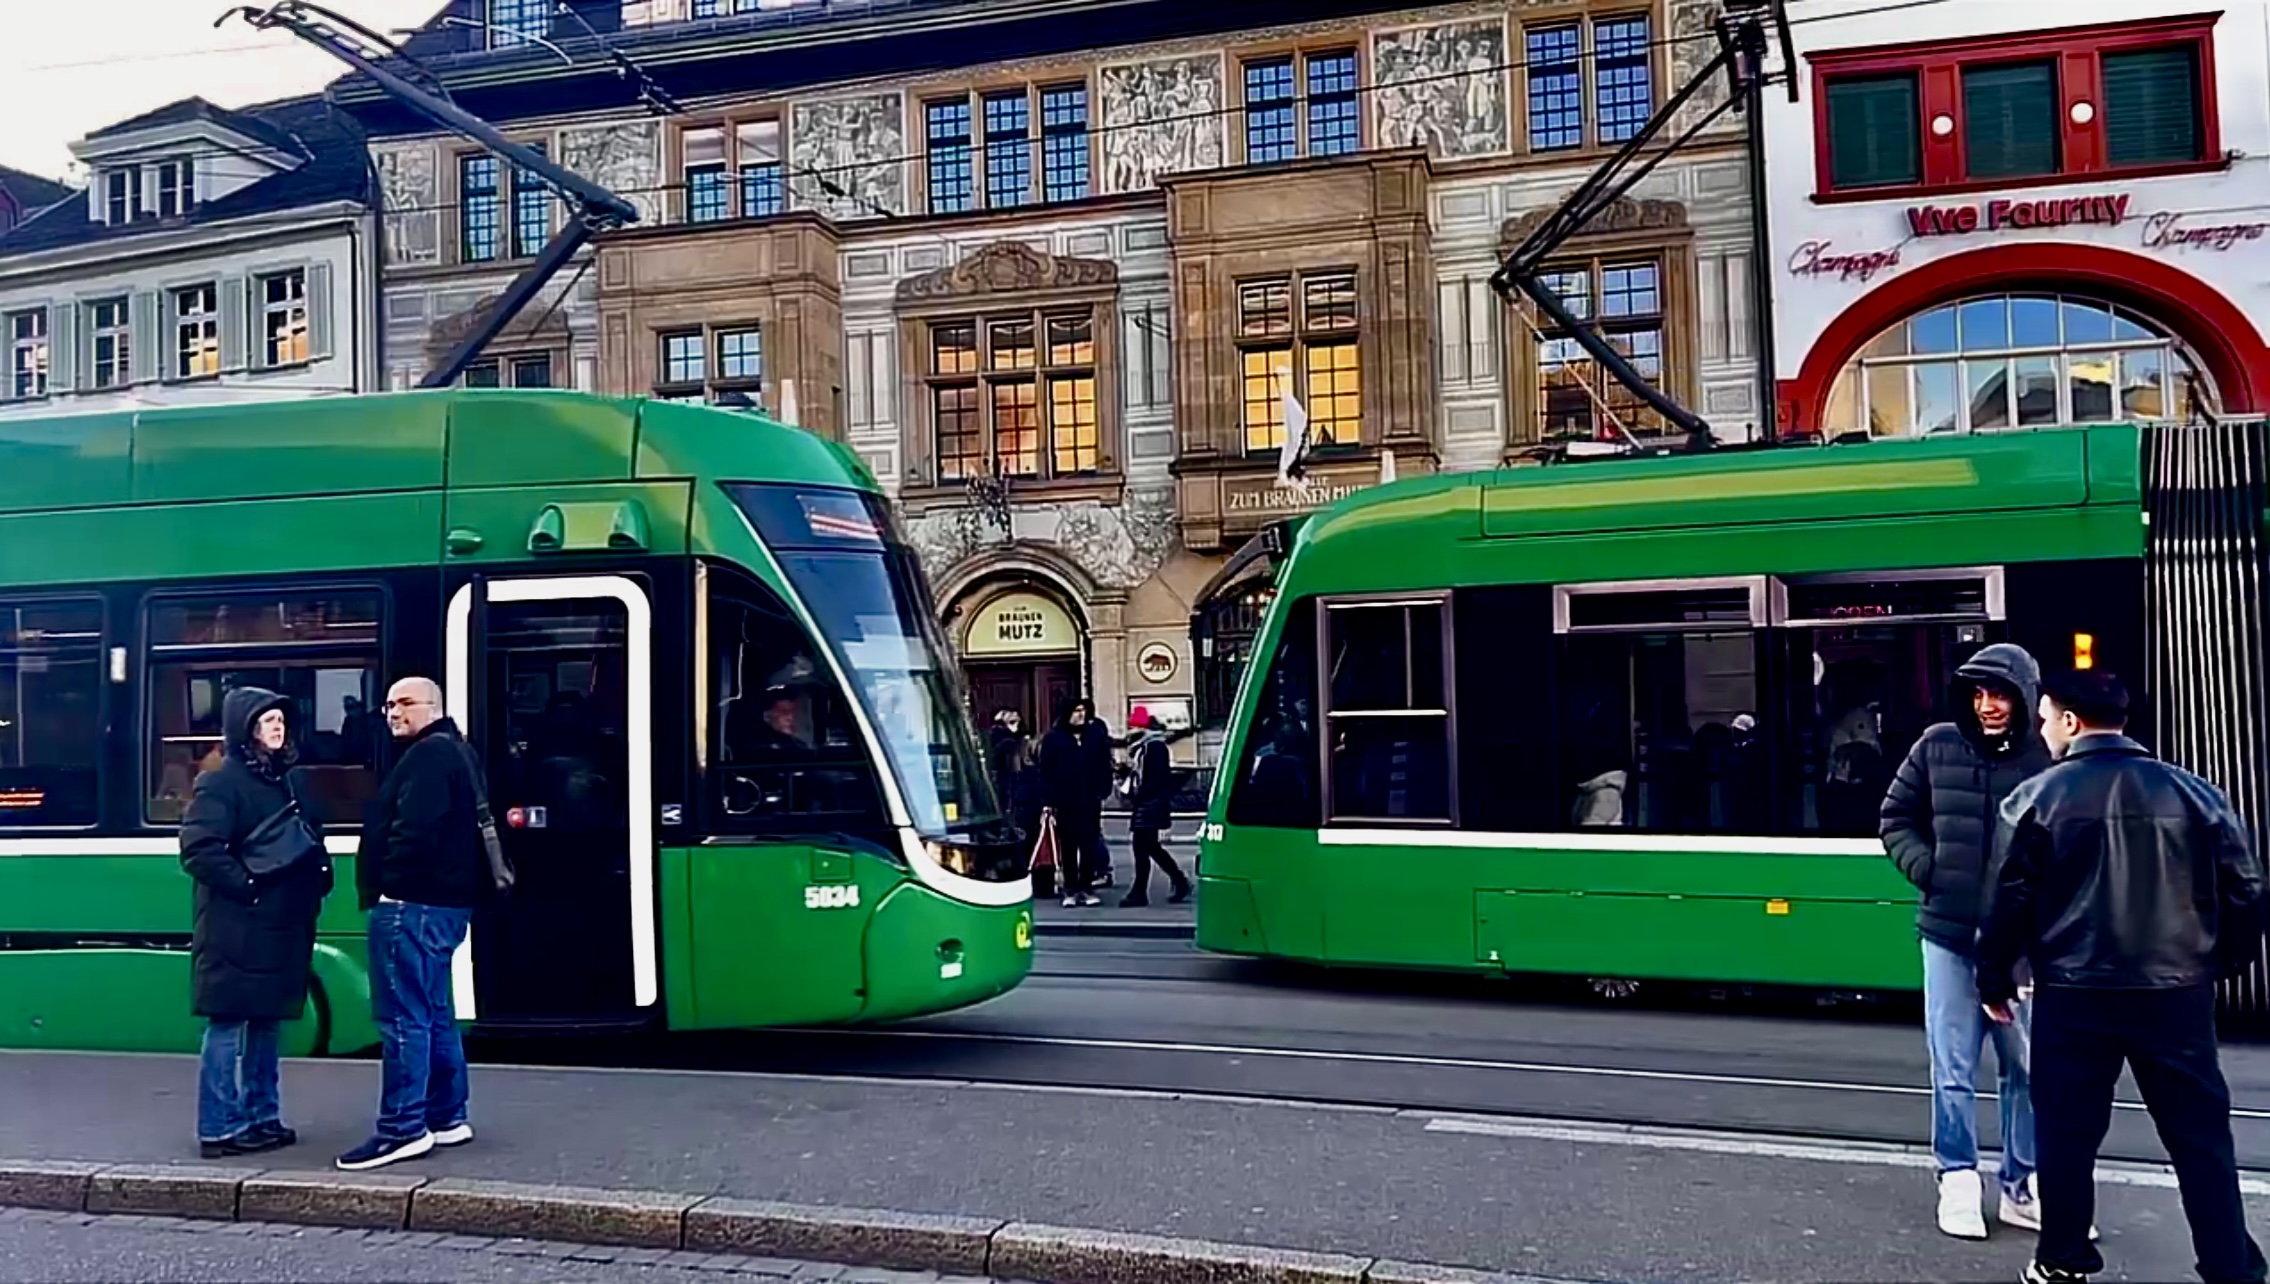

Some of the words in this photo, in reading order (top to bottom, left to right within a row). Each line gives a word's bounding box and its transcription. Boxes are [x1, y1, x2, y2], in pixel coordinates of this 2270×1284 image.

[1907, 203, 1979, 237] Vve
[1988, 193, 2130, 231] Fourny
[1229, 491, 1260, 509] ZUM
[998, 624, 1043, 640] MUTZ
